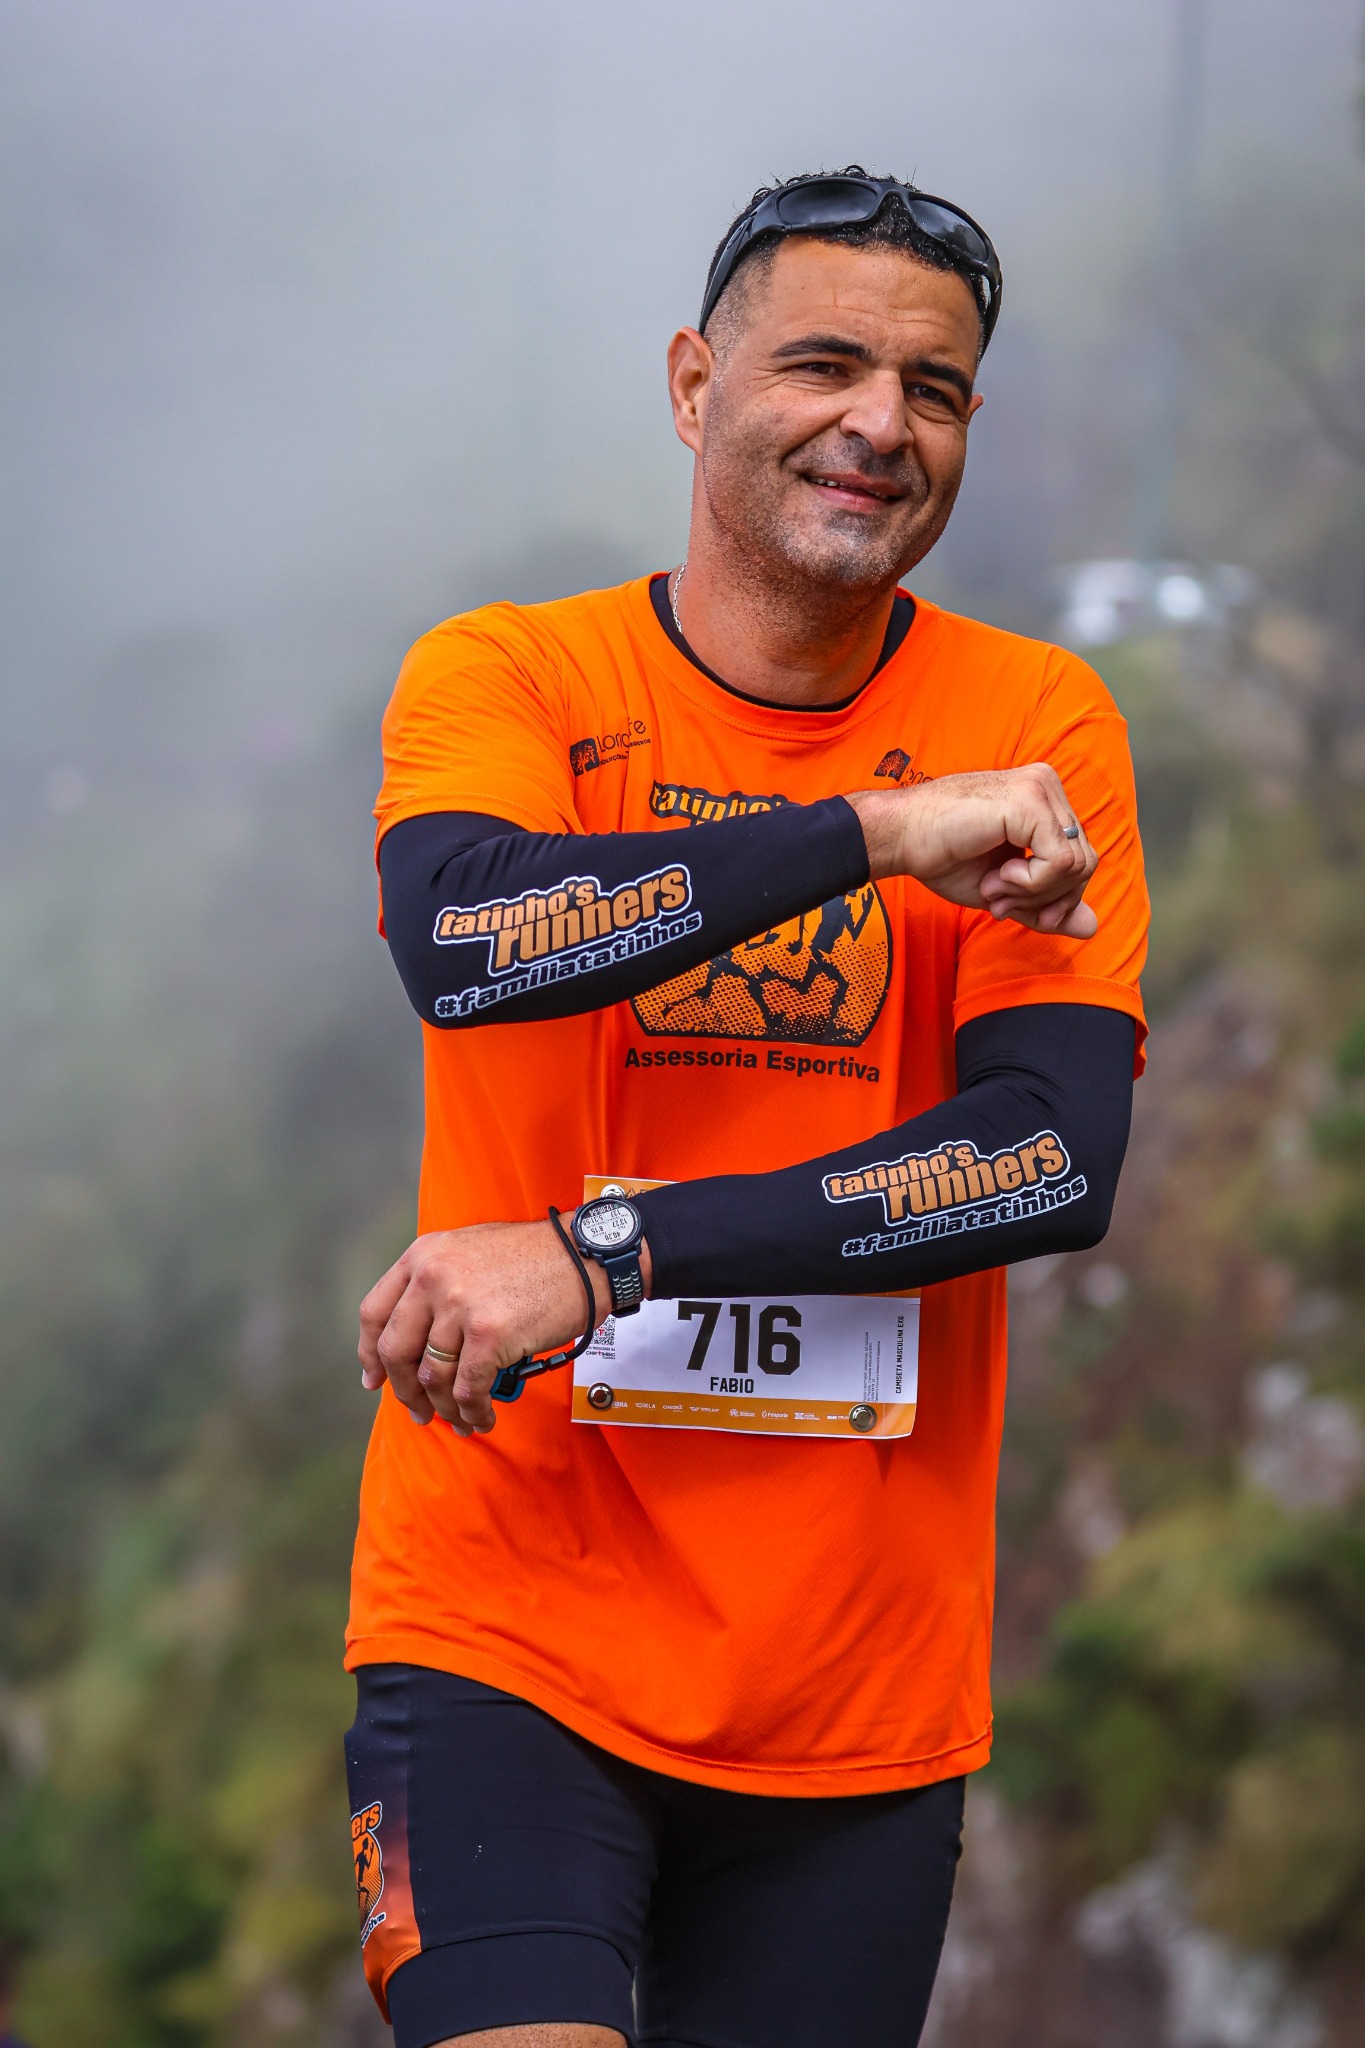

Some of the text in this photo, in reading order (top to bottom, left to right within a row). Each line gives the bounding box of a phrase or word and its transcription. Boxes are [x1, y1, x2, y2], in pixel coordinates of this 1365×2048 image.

[437, 880, 596, 940] tatinho's
[493, 868, 690, 970] runners
[435, 911, 703, 1017] #familiatatinhos
[625, 1048, 881, 1083] Assessoria Esportiva
[827, 1143, 977, 1198] tatinho's
[886, 1133, 1067, 1222] runners
[841, 1175, 1088, 1257] #familiatatinhos
[678, 1300, 802, 1375] 716
[896, 1329, 904, 1363] MASCULINA
[710, 1377, 755, 1394] FABIO
[895, 1364, 903, 1394] CAMISETA
